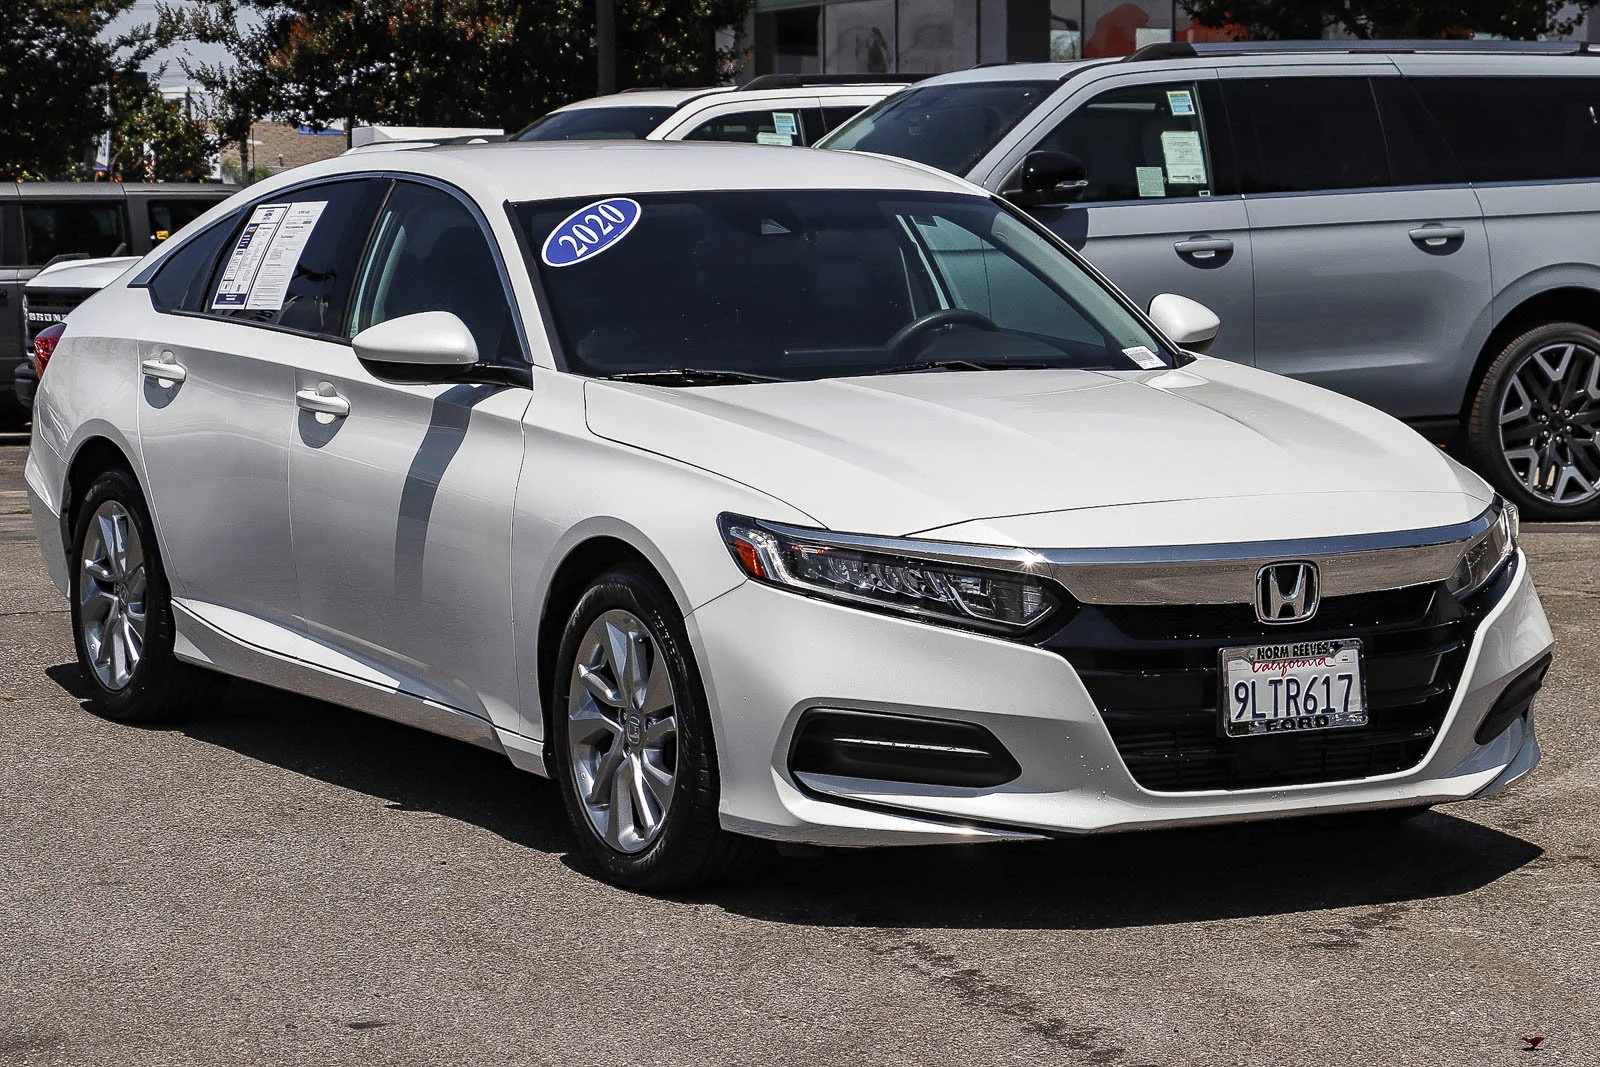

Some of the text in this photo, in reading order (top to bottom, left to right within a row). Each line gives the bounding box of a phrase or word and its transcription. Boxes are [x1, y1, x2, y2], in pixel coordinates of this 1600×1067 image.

[558, 204, 625, 258] 2020
[1265, 563, 1310, 620] H
[1252, 657, 1336, 677] California
[1257, 642, 1328, 660] NORM REEVES
[1234, 674, 1353, 720] 9LTR617
[1266, 714, 1330, 732] FORD
